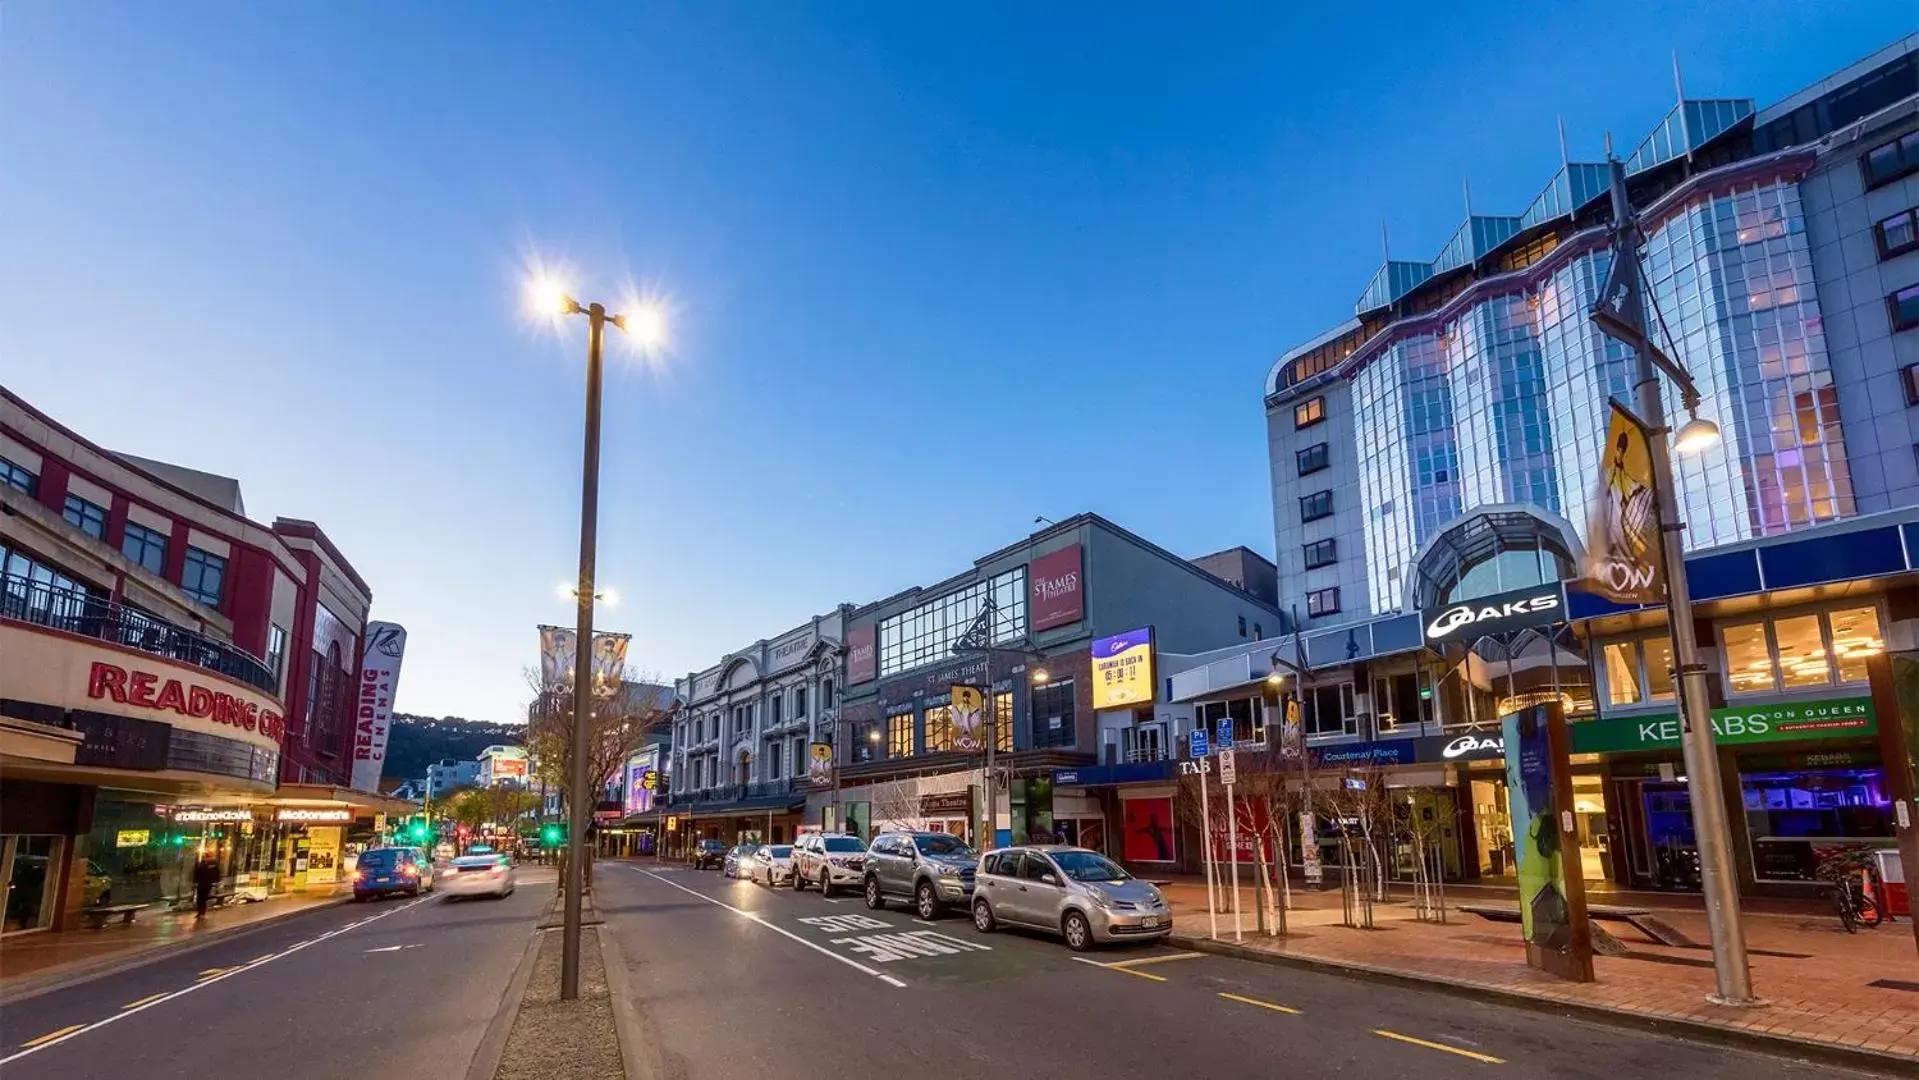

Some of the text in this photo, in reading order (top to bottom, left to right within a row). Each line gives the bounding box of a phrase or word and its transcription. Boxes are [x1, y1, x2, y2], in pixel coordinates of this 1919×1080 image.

[1427, 594, 1558, 638] OAKS
[88, 661, 258, 731] READING
[355, 669, 379, 761] READING
[373, 669, 390, 761] CINEMAS
[1639, 713, 1769, 742] KEABS
[1774, 711, 1795, 719] ON
[1805, 705, 1865, 717] QUEEN
[1179, 761, 1211, 775] TAB
[1325, 749, 1399, 762] Courtenay Place
